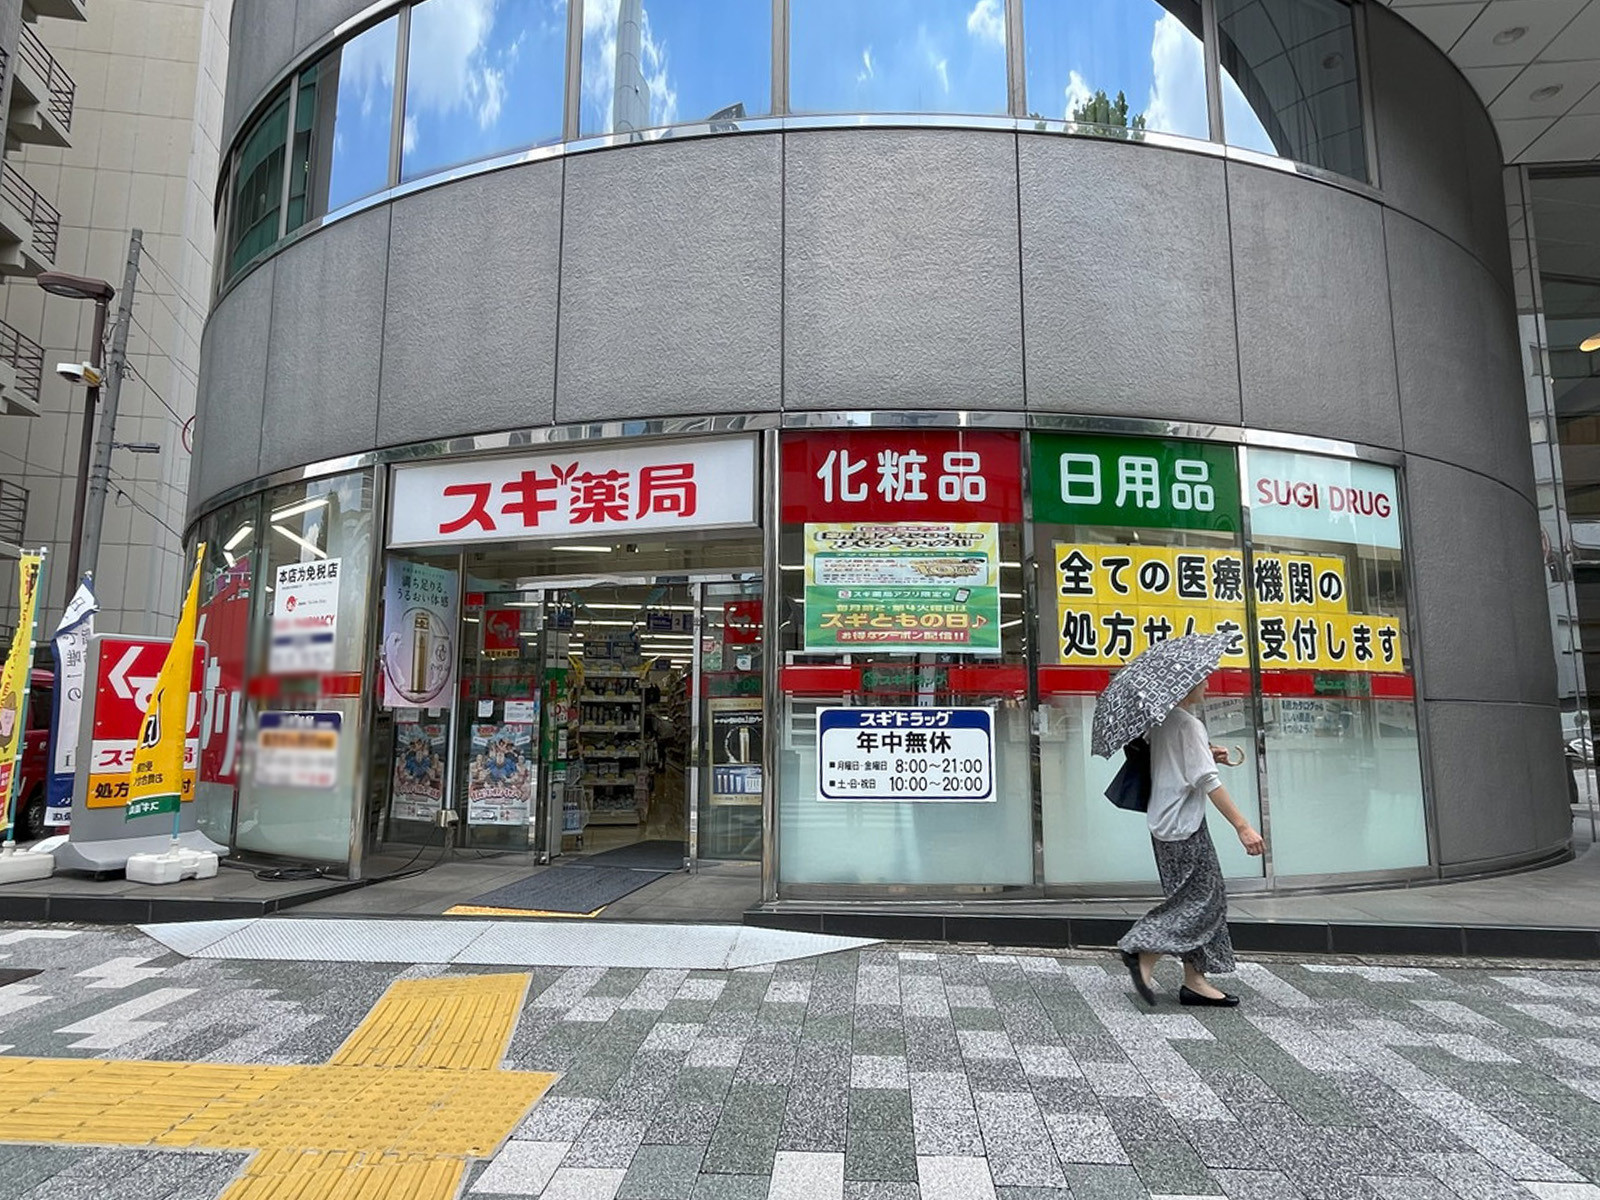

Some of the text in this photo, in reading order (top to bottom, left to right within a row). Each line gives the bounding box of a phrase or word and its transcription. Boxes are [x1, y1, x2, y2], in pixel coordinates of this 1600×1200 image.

[438, 462, 698, 534] スギ薬局
[816, 449, 988, 504] 化粧品
[1059, 452, 1215, 512] 日用品
[1256, 478, 1392, 519] SUGI DRUG
[1059, 550, 1343, 604] 全ての医療機関の
[1062, 611, 1398, 663] 処方せを受付します
[856, 730, 952, 755] 年中無休
[859, 710, 952, 728] スギドラッグ
